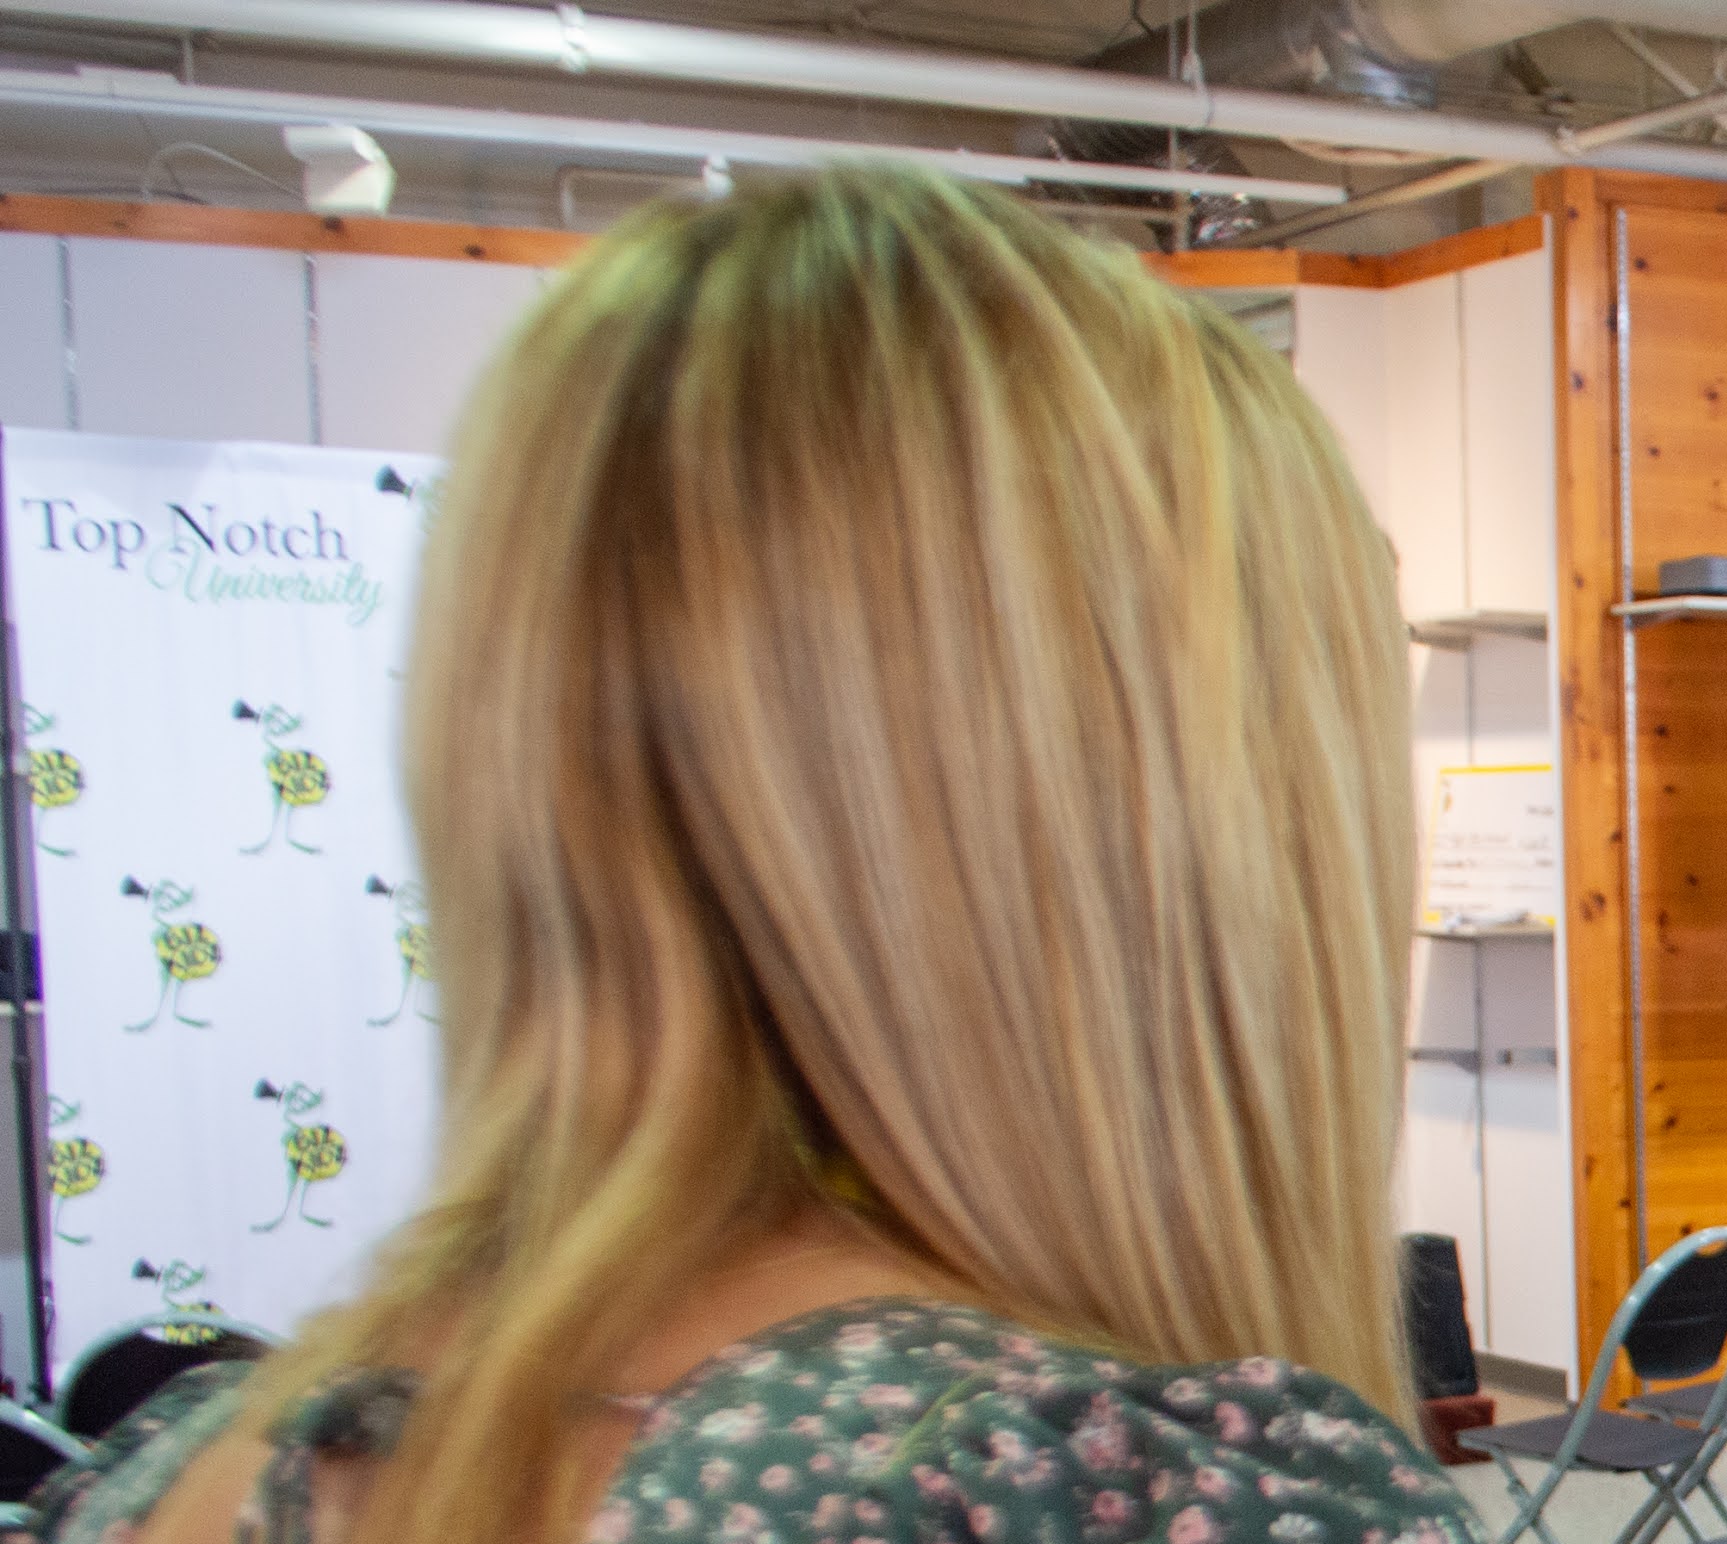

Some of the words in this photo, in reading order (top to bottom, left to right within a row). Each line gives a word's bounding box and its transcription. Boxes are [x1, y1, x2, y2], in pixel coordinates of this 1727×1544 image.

[22, 498, 146, 569] Top
[166, 502, 349, 561] Notch
[145, 536, 385, 627] University
